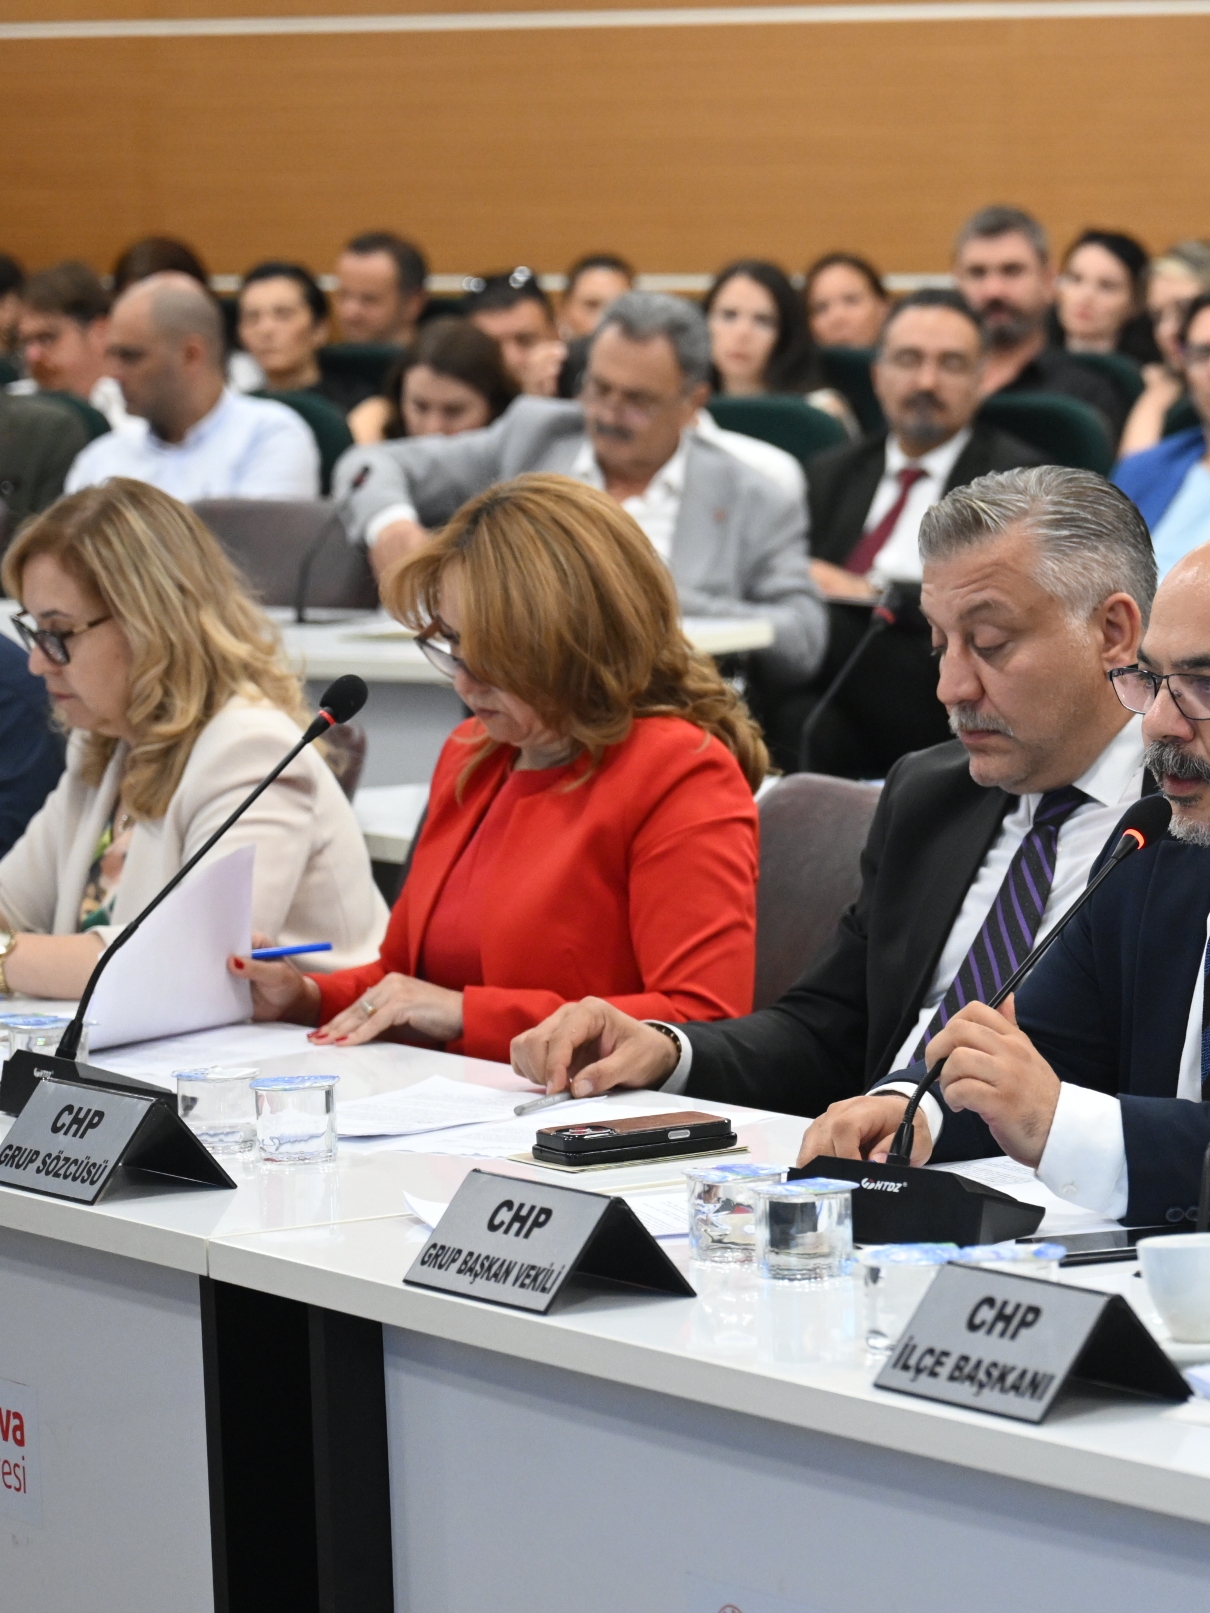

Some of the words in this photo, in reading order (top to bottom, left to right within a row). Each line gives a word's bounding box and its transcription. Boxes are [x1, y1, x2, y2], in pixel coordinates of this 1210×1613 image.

[51, 1104, 105, 1140] CHP
[0, 1144, 41, 1171] GRUP
[36, 1150, 109, 1186] SÖZCÜSÜ
[487, 1199, 553, 1240] CHP
[420, 1242, 463, 1272] GRUP
[456, 1251, 518, 1285] BAŞKAN
[511, 1262, 566, 1295] VEKİLİ
[966, 1296, 1043, 1342] CHP
[891, 1335, 952, 1383] İLÇE
[947, 1354, 1056, 1402] BAŞKANI
